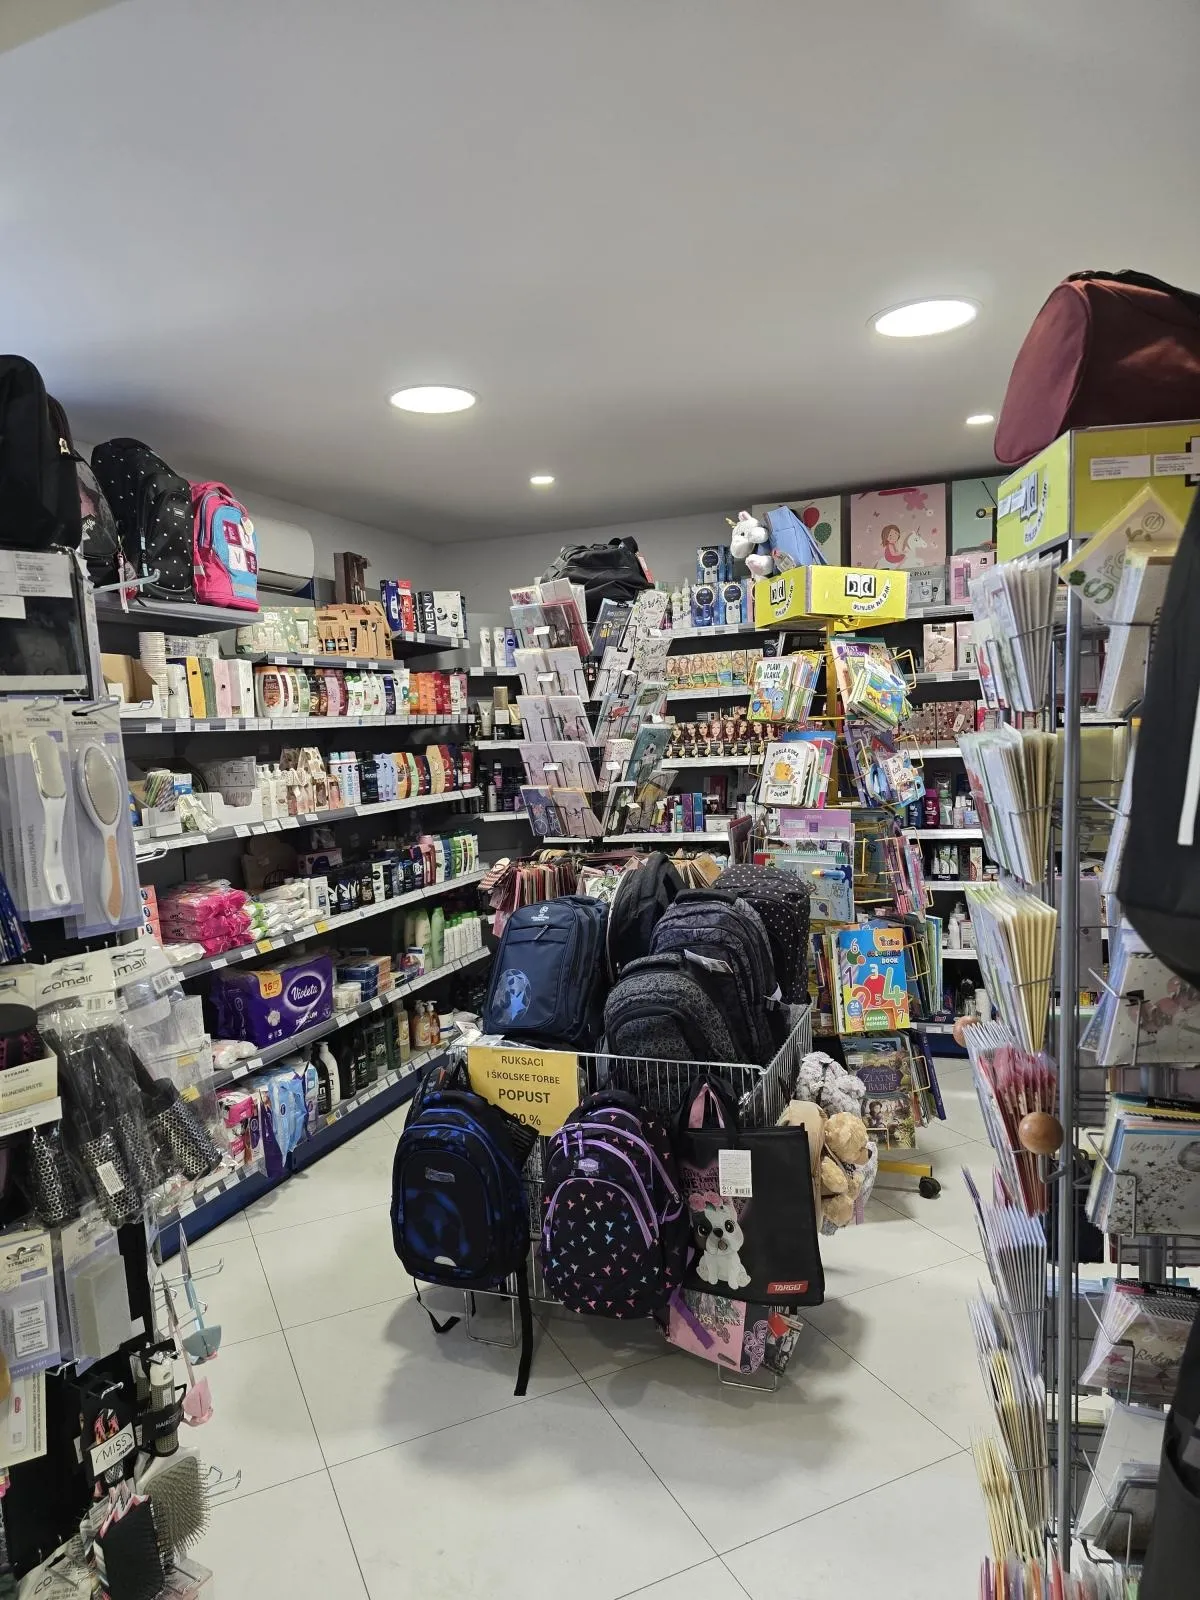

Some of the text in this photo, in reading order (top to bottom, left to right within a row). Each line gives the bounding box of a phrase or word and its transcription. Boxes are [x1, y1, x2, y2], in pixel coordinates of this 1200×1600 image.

[424, 602, 436, 632] MEN
[42, 974, 93, 995] comair
[263, 982, 273, 992] 16
[291, 983, 318, 1001] Violeta
[501, 1055, 544, 1067] RUKSACI
[491, 1069, 530, 1082] ŠKOLSKE
[532, 1074, 561, 1085] TORBE
[863, 1073, 897, 1083] ZLATNE
[868, 1082, 893, 1091] BAJKE
[498, 1088, 551, 1104] POPUST
[7, 1256, 35, 1268] TITANIA
[773, 1283, 803, 1292] TARGET
[103, 1435, 127, 1460] MISS
